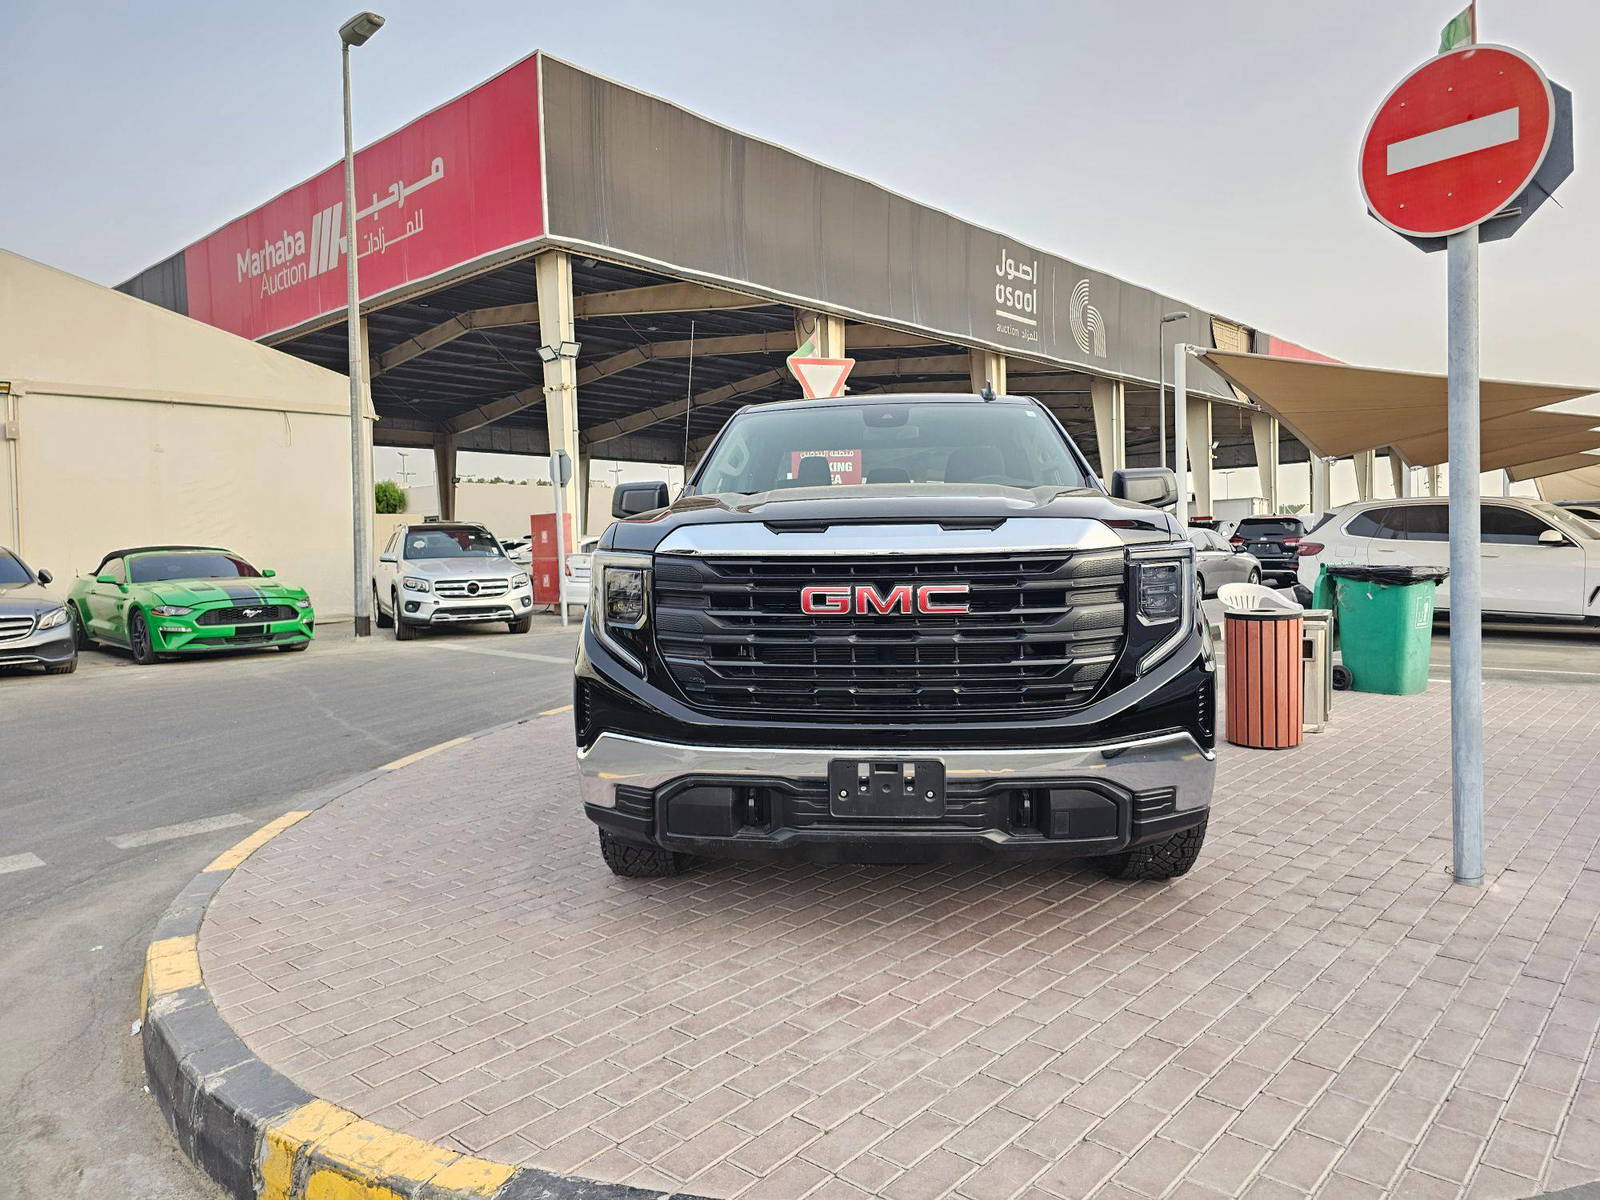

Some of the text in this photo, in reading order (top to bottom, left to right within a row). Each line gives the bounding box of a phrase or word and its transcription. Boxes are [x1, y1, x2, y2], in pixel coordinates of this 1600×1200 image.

[236, 229, 305, 282] Marhaba
[260, 261, 307, 298] Auction
[996, 323, 1020, 337] auction
[800, 584, 971, 616] GMC
